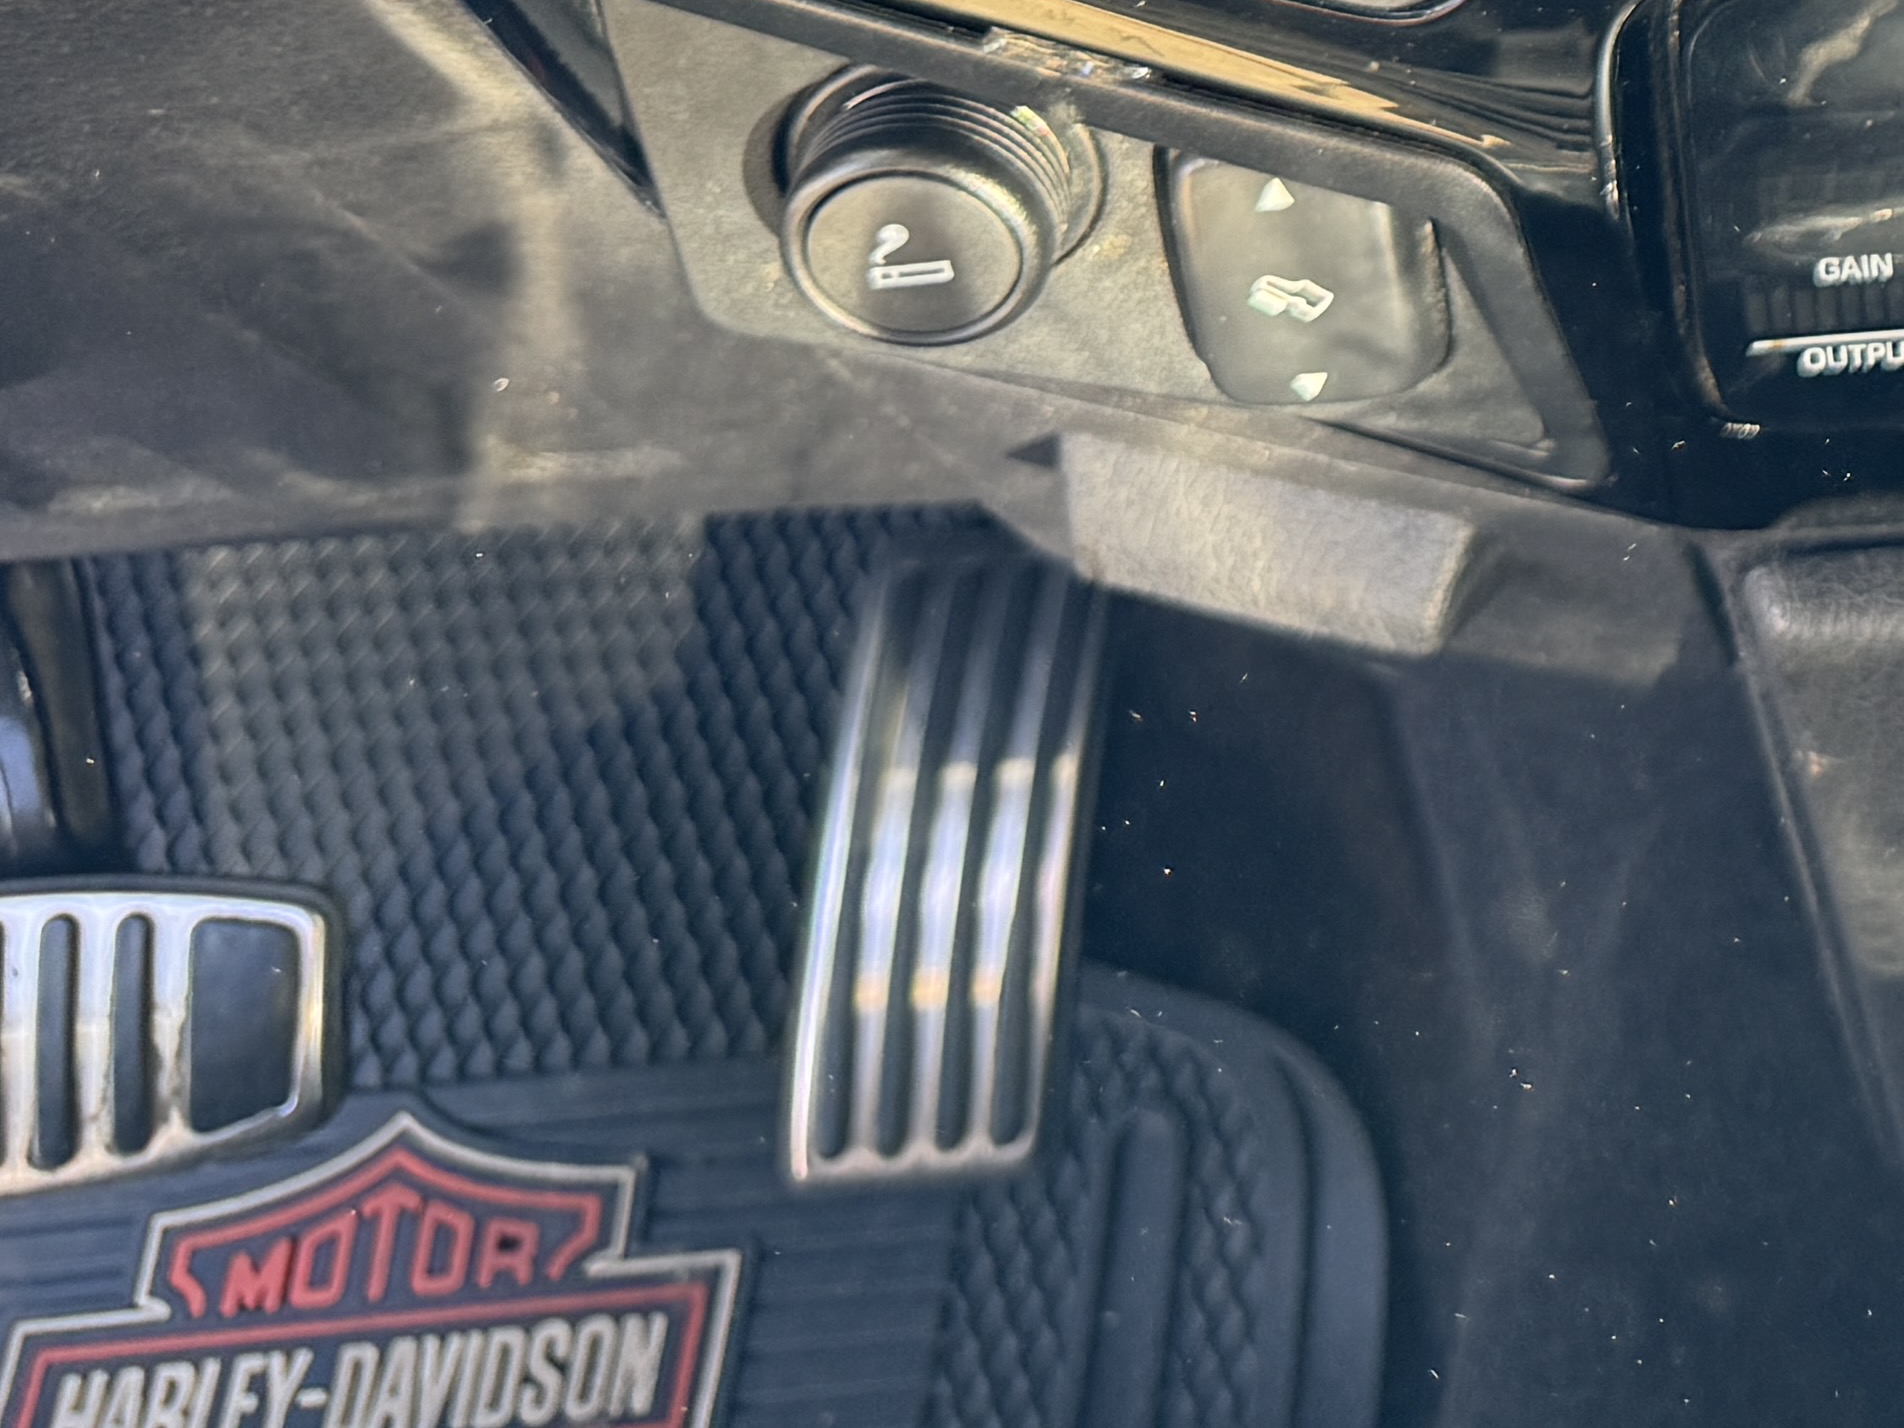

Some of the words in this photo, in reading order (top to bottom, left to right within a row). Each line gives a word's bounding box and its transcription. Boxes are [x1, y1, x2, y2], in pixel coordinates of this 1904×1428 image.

[1813, 252, 1895, 287] GAIN
[220, 1184, 540, 1318] MOTOR
[52, 1312, 668, 1428] HARLEY-DAVIDSON
